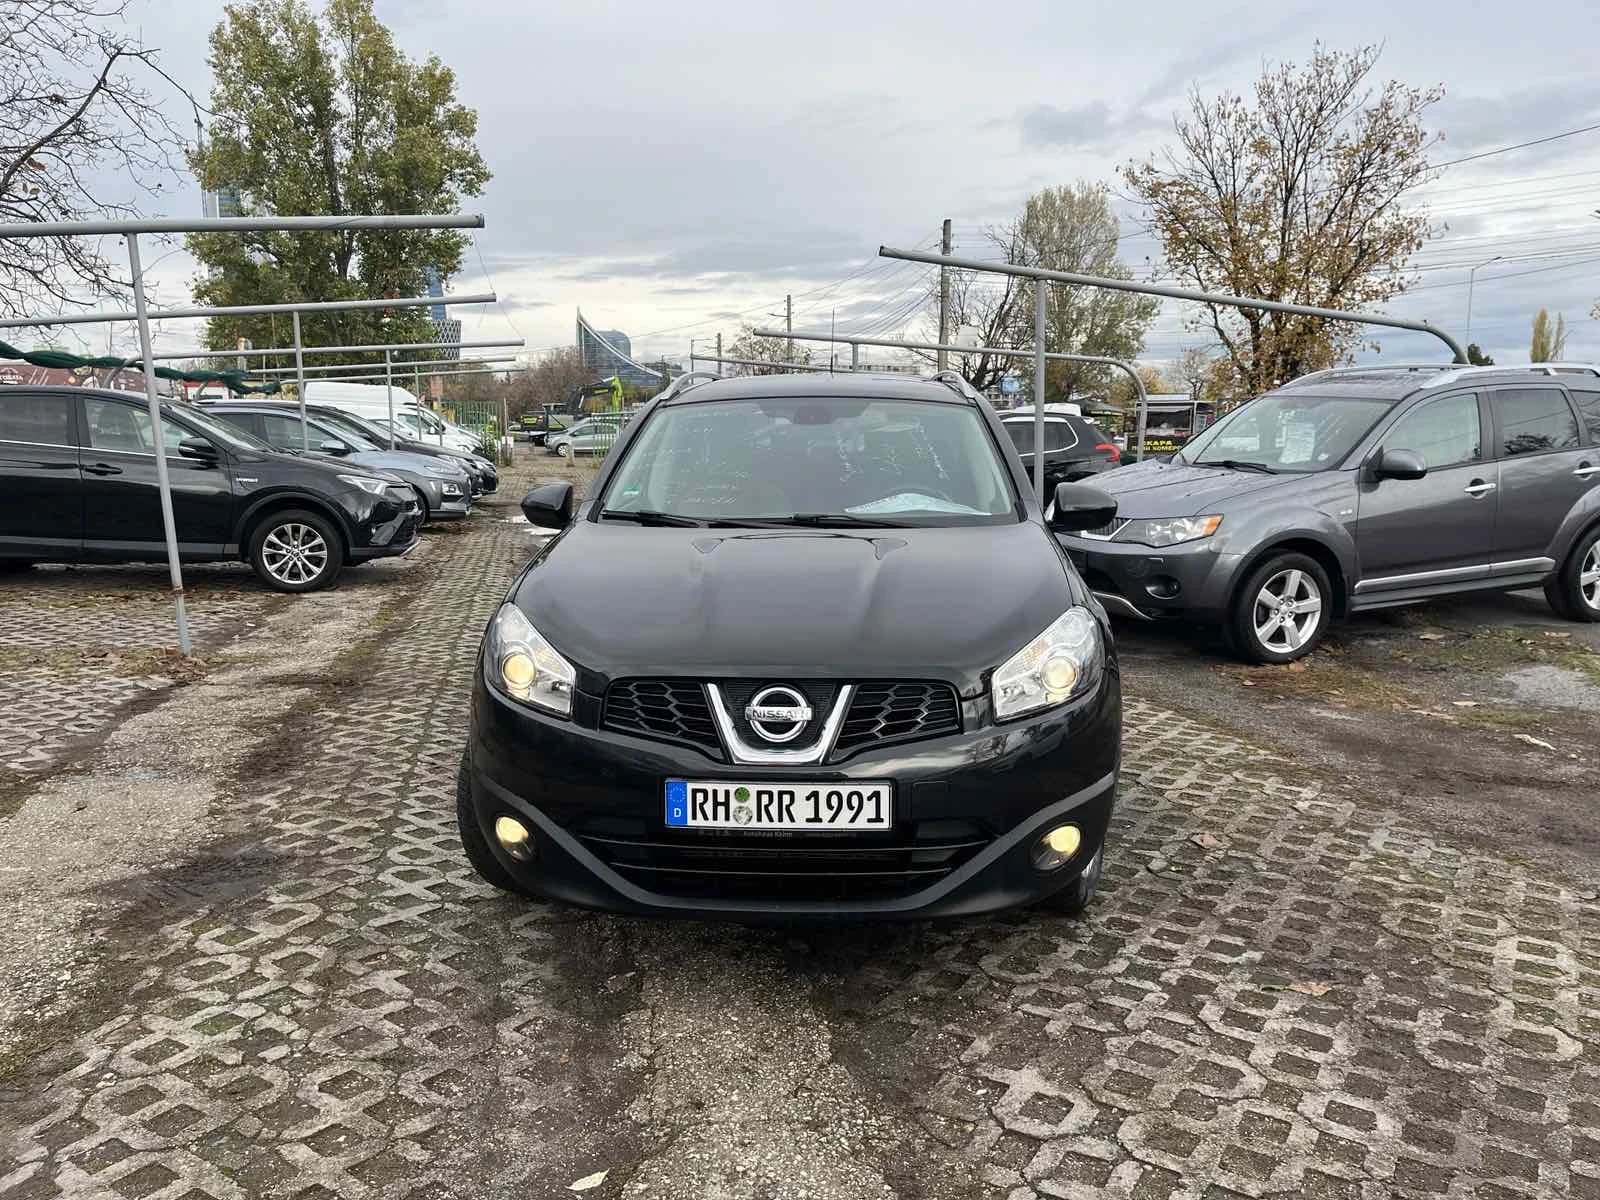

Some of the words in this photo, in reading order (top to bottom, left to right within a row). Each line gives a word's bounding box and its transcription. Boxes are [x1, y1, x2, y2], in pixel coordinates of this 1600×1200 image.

[752, 709, 806, 719] NISSAN
[691, 787, 730, 822] RH
[756, 789, 796, 823] RR
[805, 790, 884, 824] 1991
[673, 807, 682, 818] D
